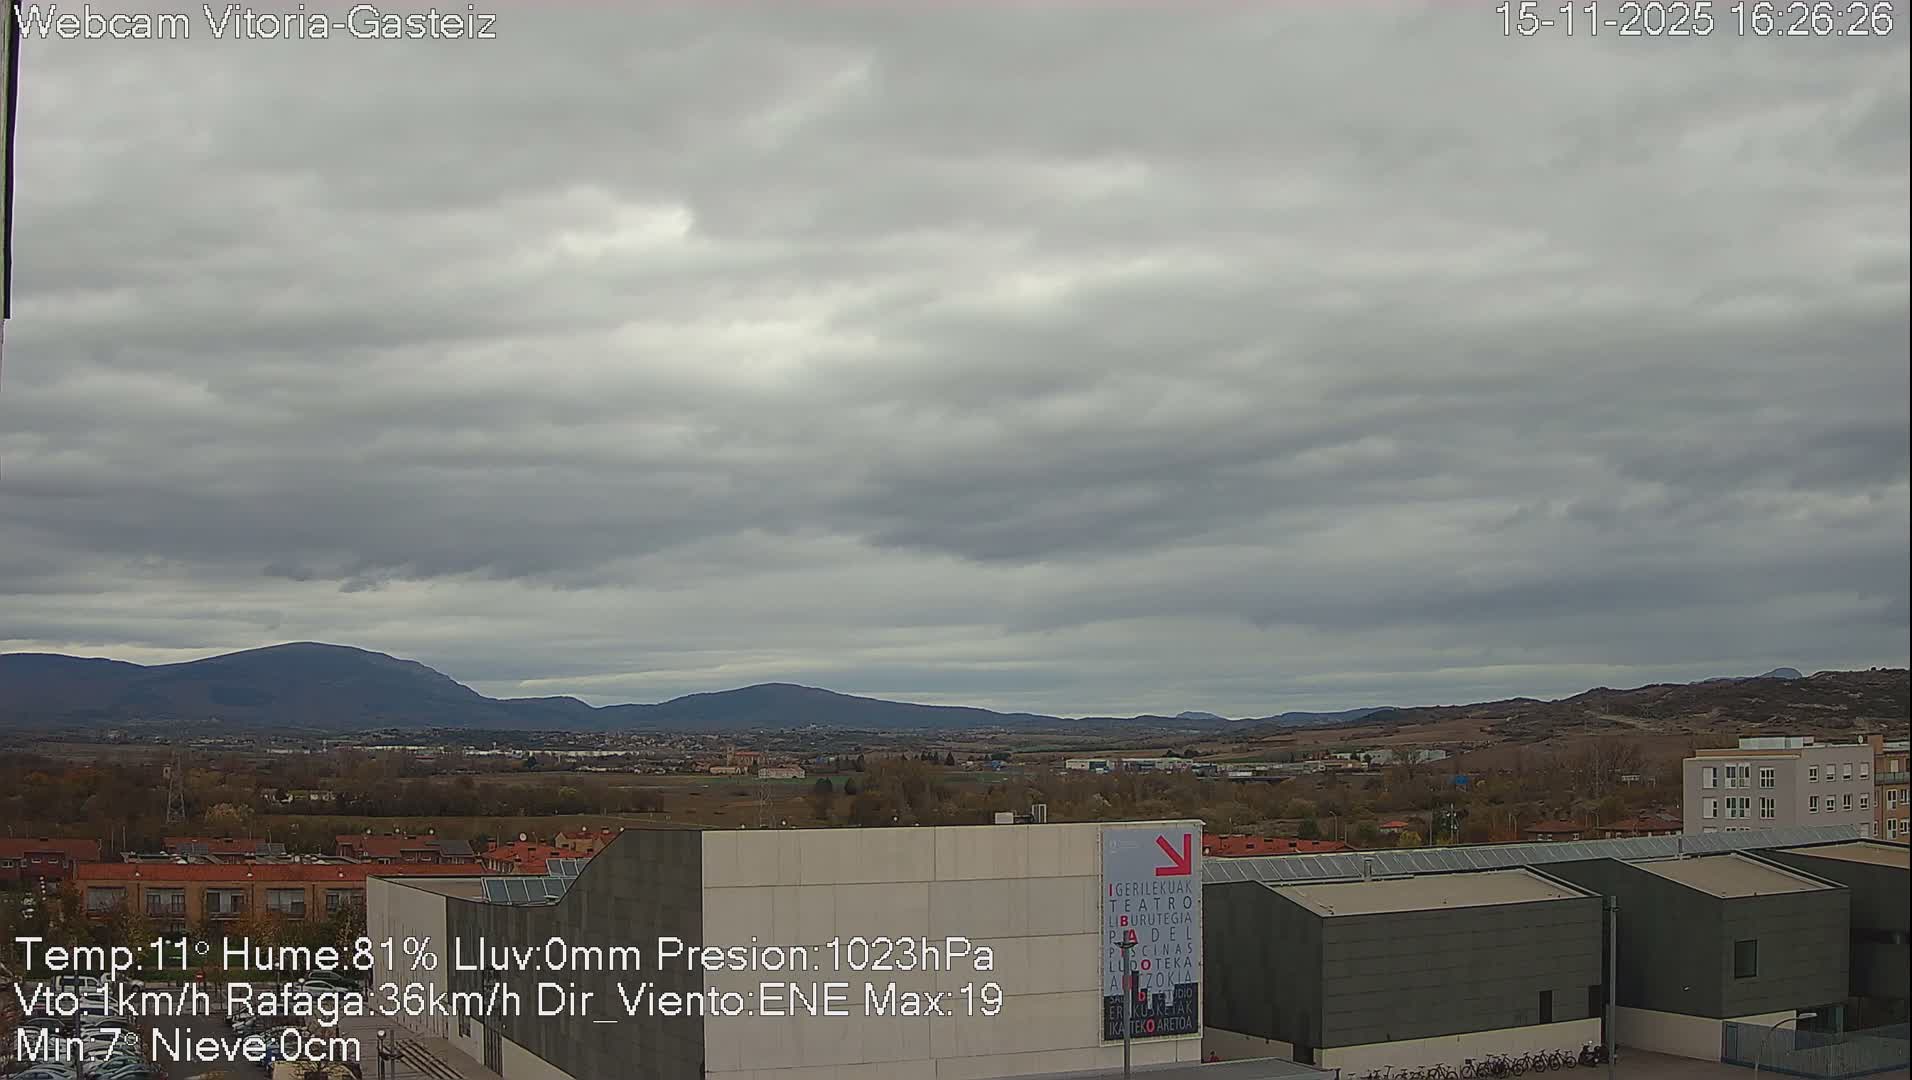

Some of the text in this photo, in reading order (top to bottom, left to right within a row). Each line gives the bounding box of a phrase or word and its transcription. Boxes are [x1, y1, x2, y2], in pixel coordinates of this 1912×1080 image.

[1109, 880, 1192, 897] IGERILEKUAK
[1109, 896, 1192, 913] TEATRO
[1109, 911, 1192, 928] LIBURUTEGIA
[1109, 1001, 1192, 1020] ERKUSKETAK
[1109, 1016, 1192, 1036] IKATEKO ARETOA
